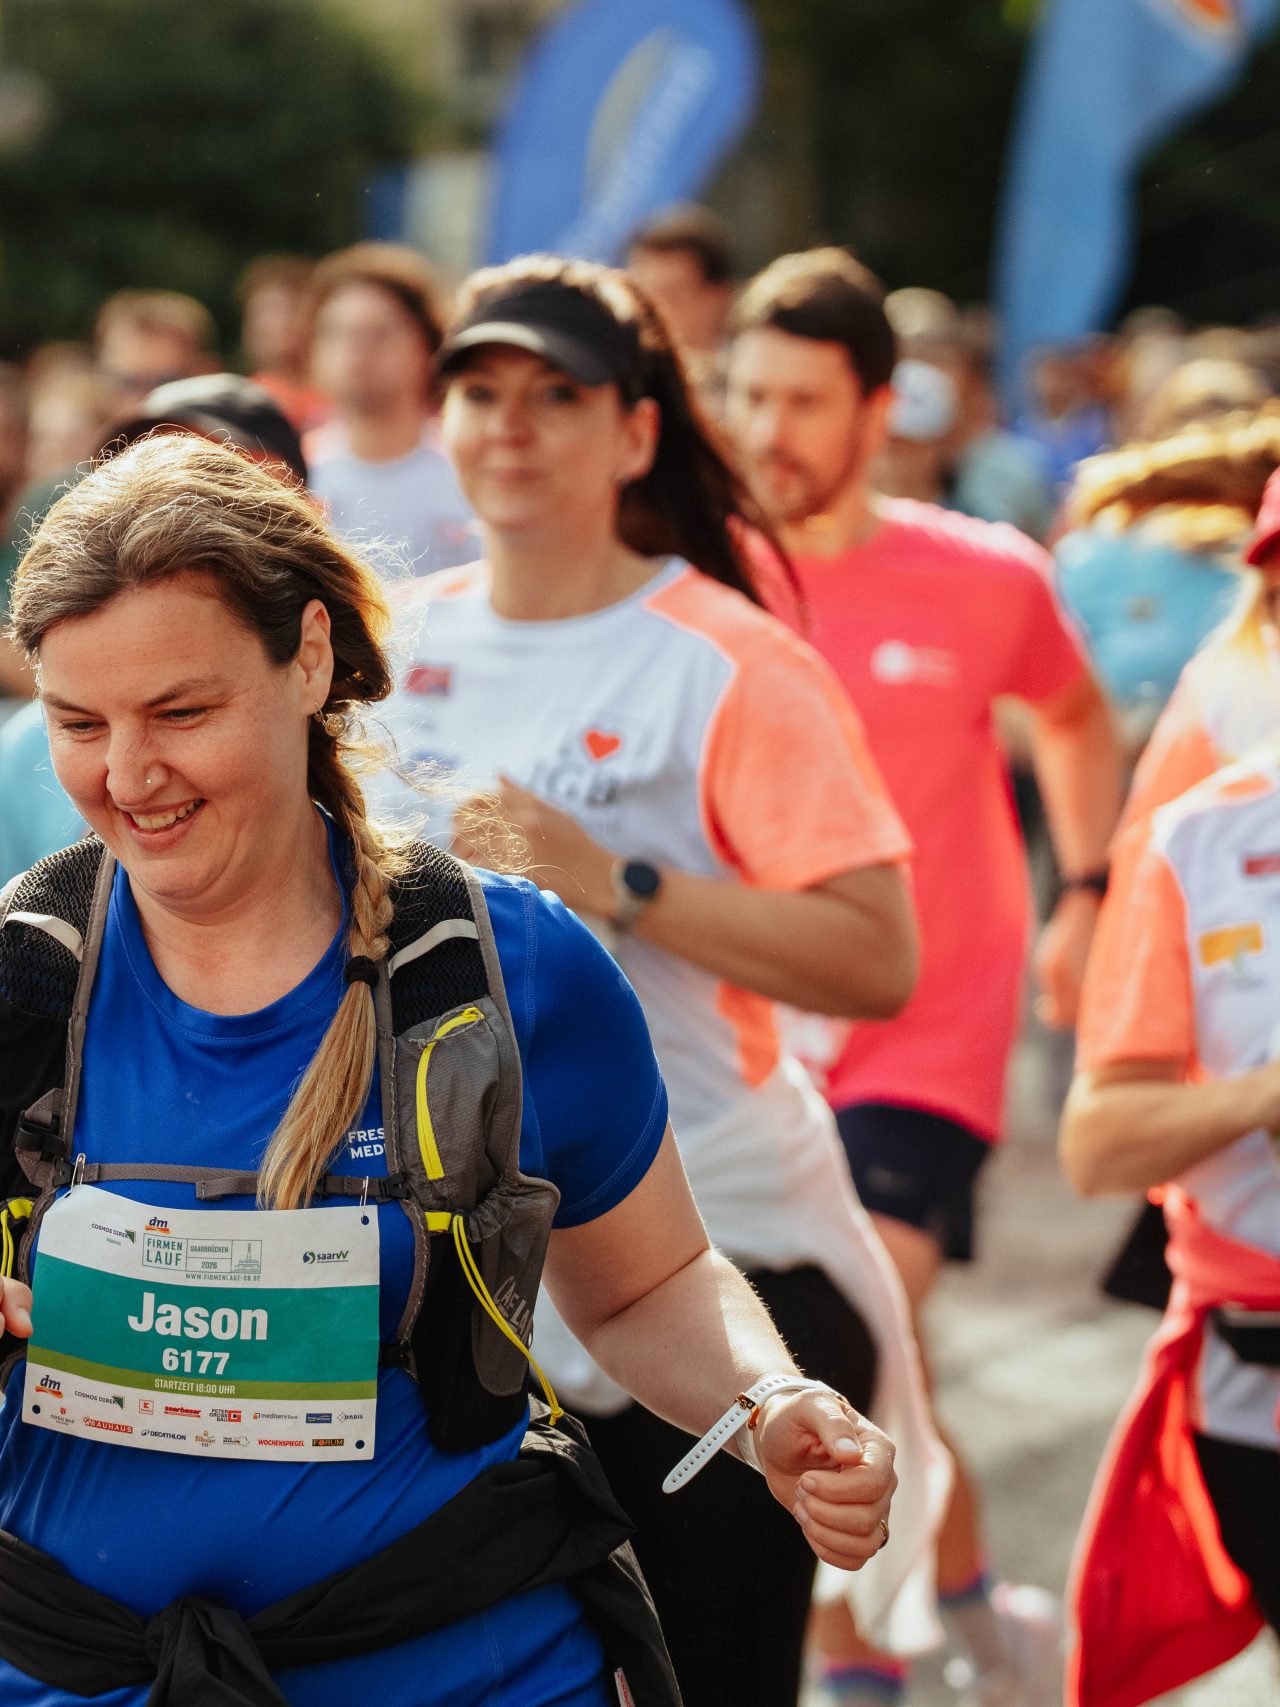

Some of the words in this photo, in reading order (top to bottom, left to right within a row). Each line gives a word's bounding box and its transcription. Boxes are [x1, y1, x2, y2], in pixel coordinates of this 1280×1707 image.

[348, 1128, 385, 1143] FRES
[350, 1144, 385, 1159] MED
[91, 1223, 112, 1234] COSMOS
[149, 1217, 168, 1229] dm
[147, 1238, 183, 1251] FIRMEN
[147, 1250, 183, 1266] LAUF
[201, 1261, 218, 1269] 2026
[128, 1292, 268, 1340] Jason
[162, 1347, 230, 1375] 6177
[40, 1374, 61, 1391] dm
[154, 1378, 195, 1392] STARTZEIT
[195, 1383, 217, 1394] 18:00
[218, 1385, 236, 1395] UHR
[74, 1391, 98, 1401] COSMOS
[150, 1430, 186, 1440] DECATHLON
[313, 1439, 344, 1447] FORUM
